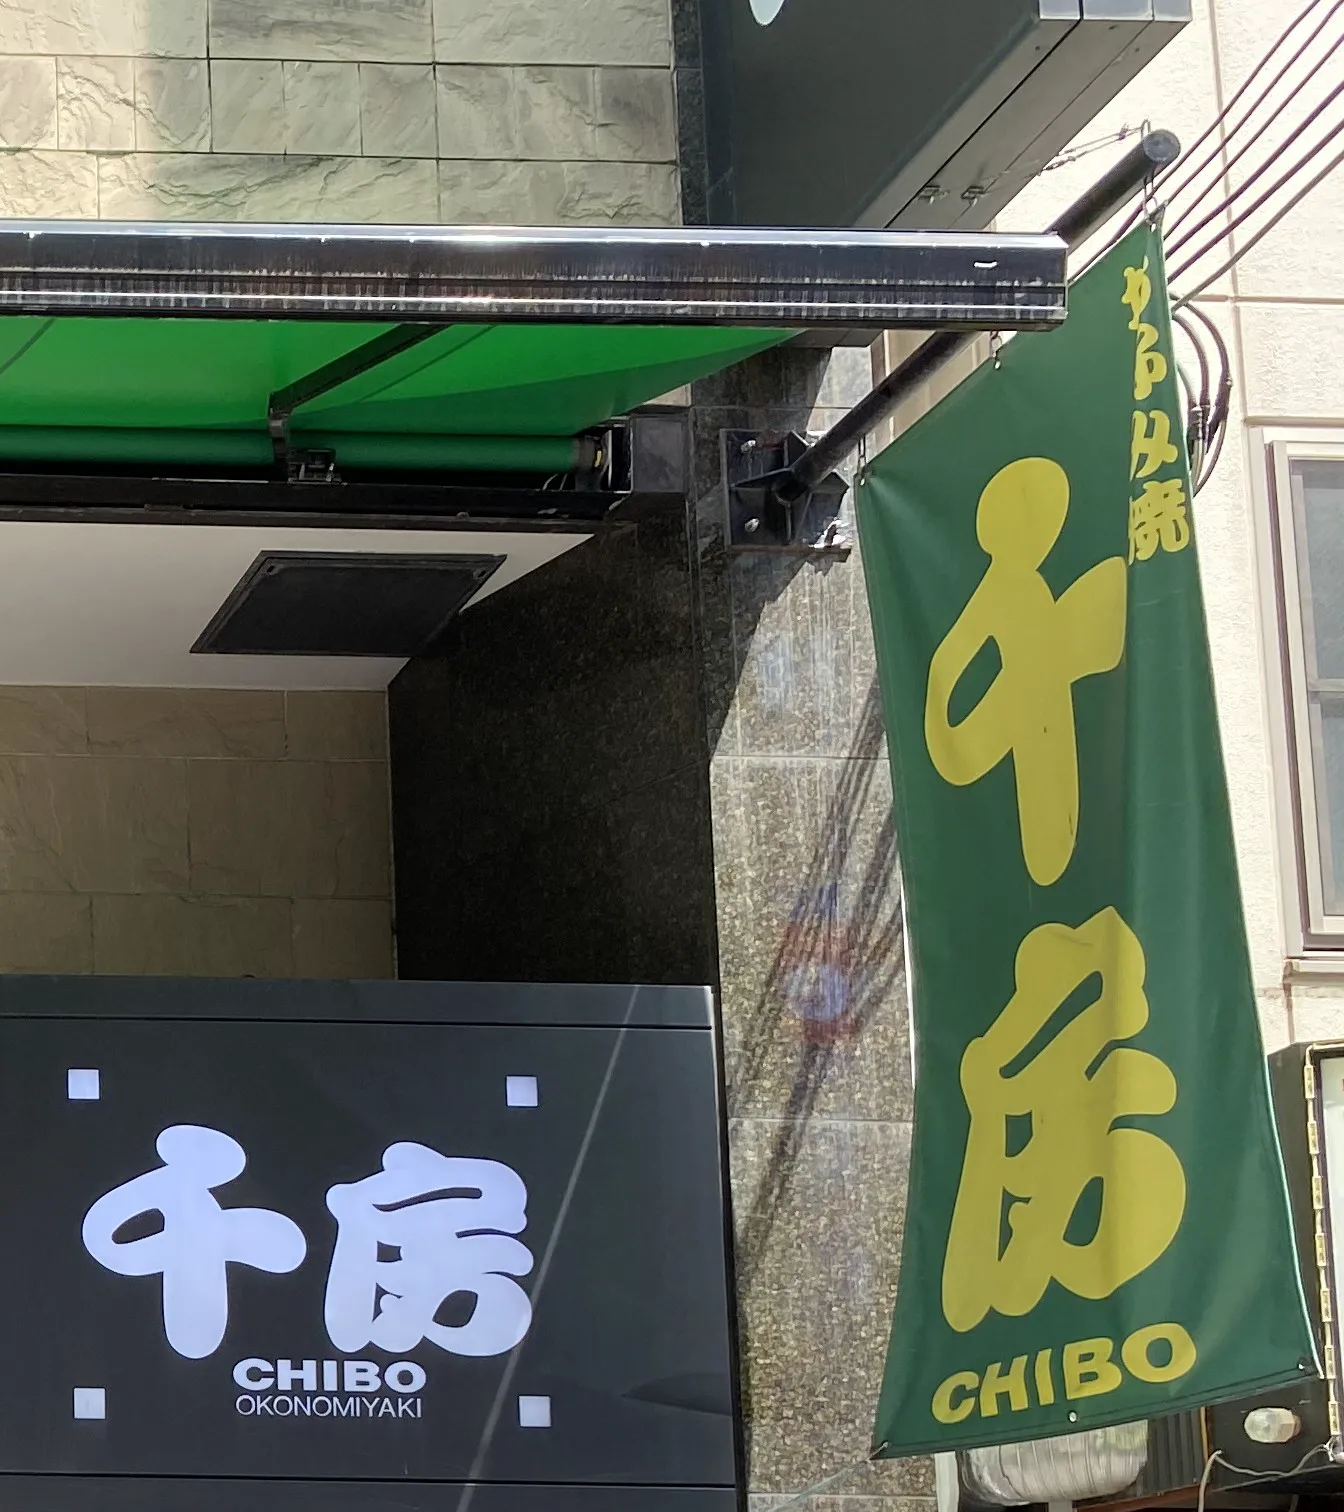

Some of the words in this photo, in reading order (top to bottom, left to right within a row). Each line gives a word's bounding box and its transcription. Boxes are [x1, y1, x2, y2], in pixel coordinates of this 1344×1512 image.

[924, 455, 1185, 1333] 千房
[82, 1123, 534, 1360] 千房
[233, 1358, 427, 1393] CHIBO
[235, 1395, 423, 1419] OKONOMIYAKI
[931, 1321, 1198, 1424] CHIBO
